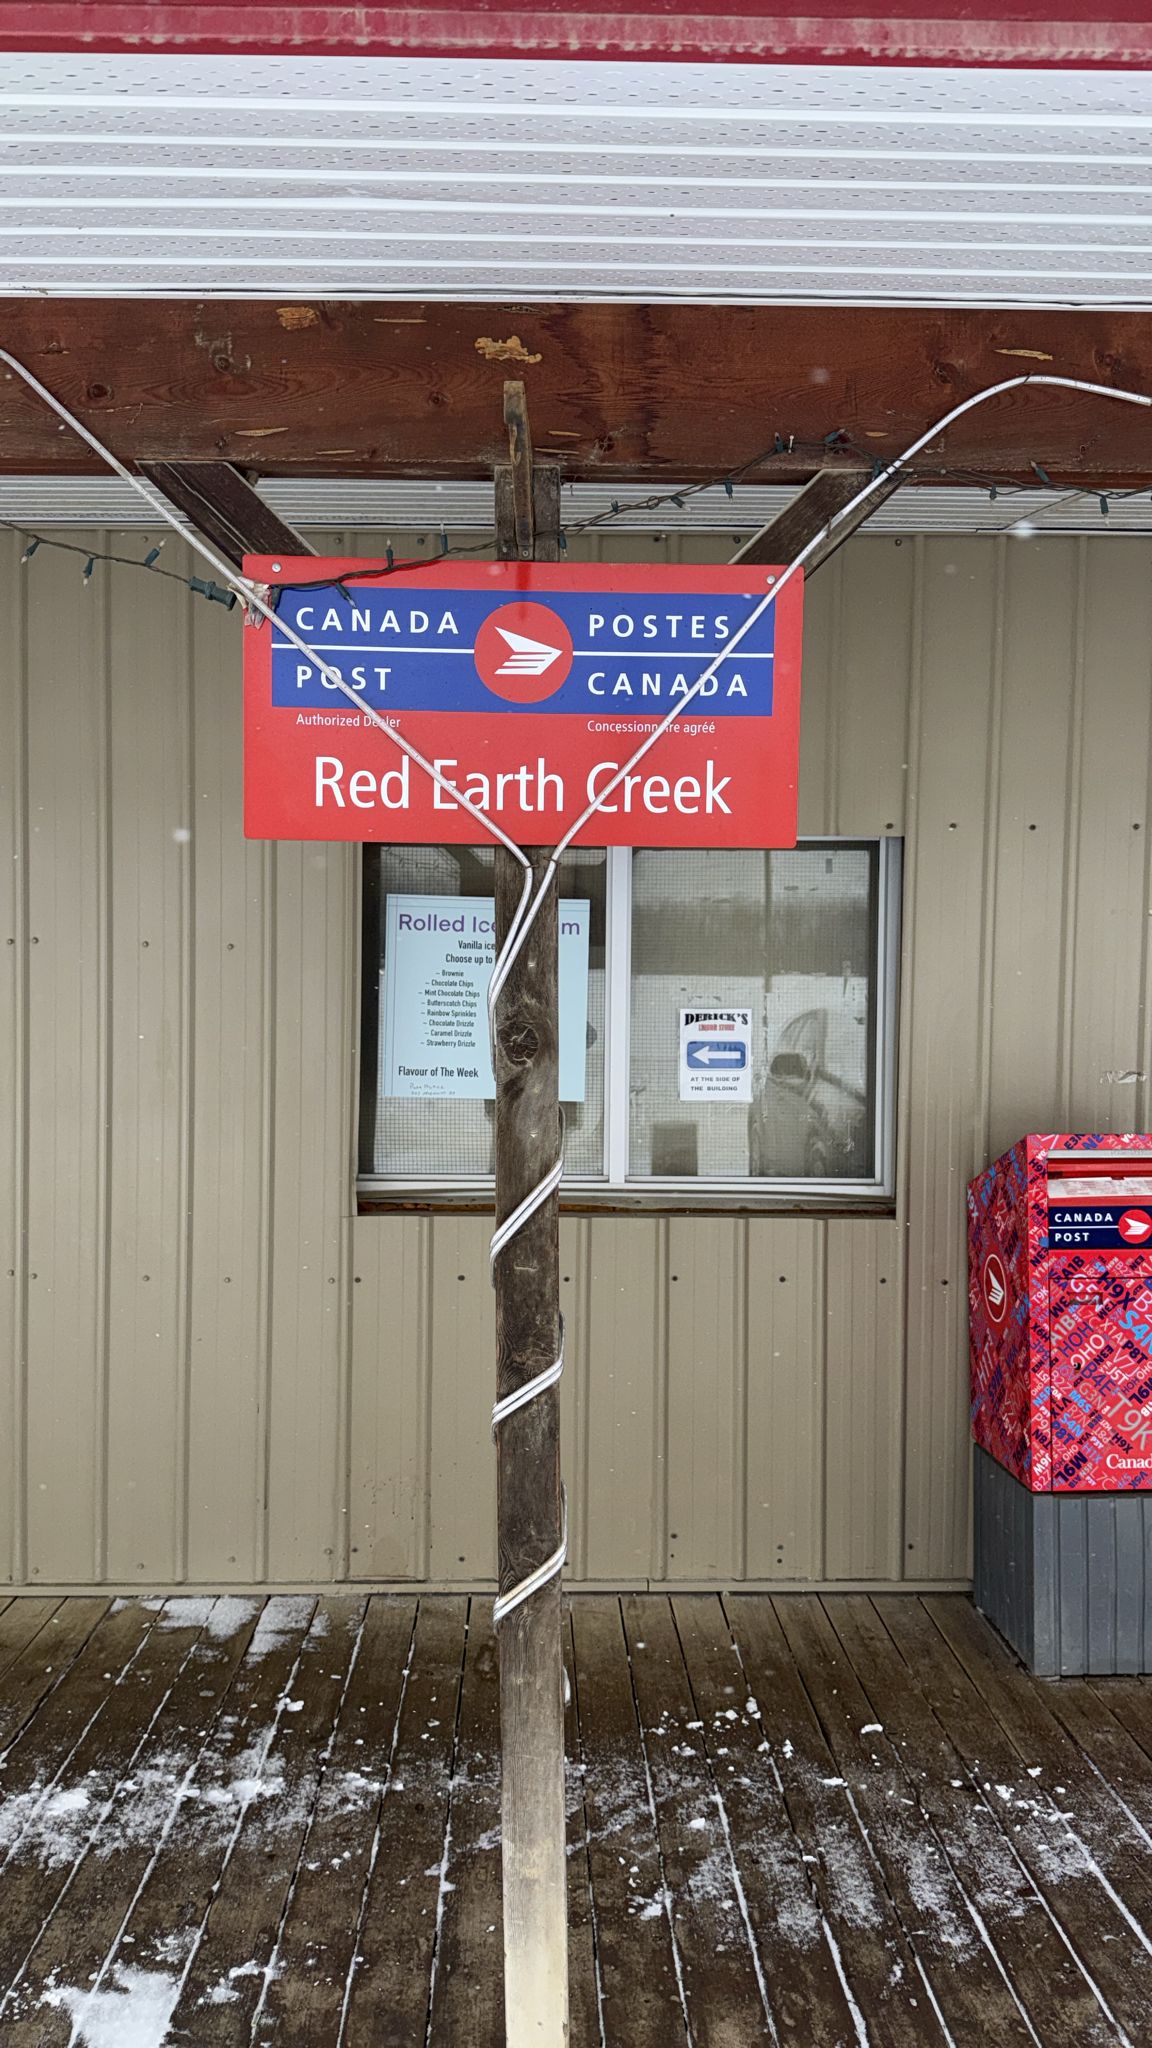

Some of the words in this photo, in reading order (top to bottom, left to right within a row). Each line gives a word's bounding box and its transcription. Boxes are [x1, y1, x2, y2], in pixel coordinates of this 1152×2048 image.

[296, 607, 459, 634] CANADA
[589, 614, 729, 638] POSTES
[296, 665, 392, 690] POST
[587, 672, 748, 697] CANADA
[296, 713, 359, 727] Authorized
[363, 715, 400, 728] Deler
[587, 720, 680, 733] Concessionnre
[683, 721, 716, 736] agréé
[315, 755, 410, 809] Red
[433, 758, 565, 812] Earth
[586, 760, 733, 814] Creek
[400, 914, 464, 932] Rolled
[458, 940, 482, 950] Vanilla
[485, 941, 495, 950] ice
[446, 953, 473, 964] Choose
[475, 955, 484, 965] up
[485, 955, 493, 964] to
[441, 969, 464, 977] Brownie
[431, 979, 457, 987] Chocolate
[459, 980, 474, 988] Chips
[438, 989, 463, 997] Chocolate
[465, 990, 480, 998] Chips
[427, 999, 461, 1007] Butterscotch
[462, 1000, 477, 1008] Chips
[451, 1009, 477, 1018] Sprinkles
[684, 1013, 748, 1026] DERICK'S
[429, 1019, 455, 1027] Chocolate
[456, 1020, 474, 1028] Drizzle
[427, 1039, 457, 1048] Strawberry
[399, 1065, 428, 1076] Flavour
[430, 1066, 438, 1076] of
[440, 1066, 455, 1077] The
[457, 1067, 479, 1078] Week
[1055, 1213, 1113, 1223] CANADA
[1055, 1233, 1090, 1242] POST
[1062, 1256, 1085, 1280] A1B
[1096, 1271, 1136, 1311] H9X
[1093, 1344, 1115, 1365] E3N
[1121, 1340, 1149, 1365] P8T
[1111, 1432, 1134, 1454] H9X
[1055, 1451, 1089, 1483] M9L
